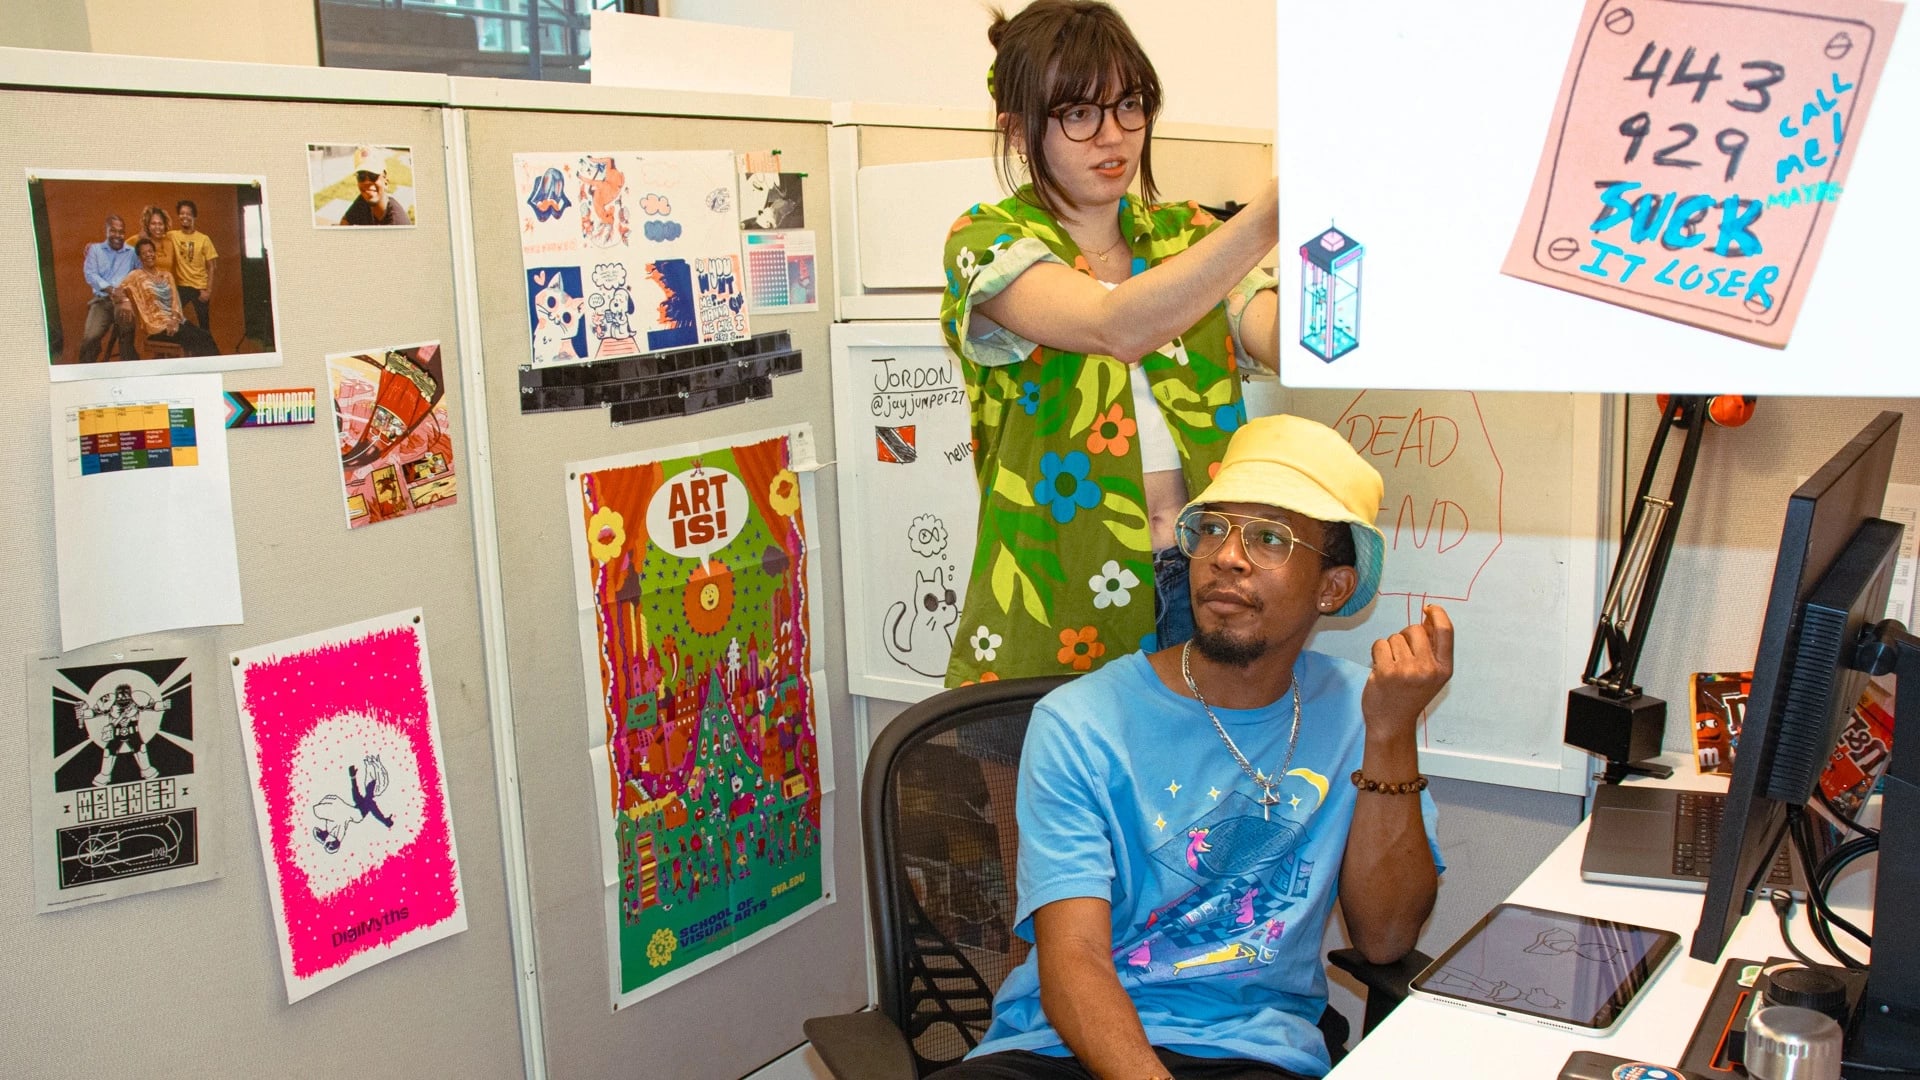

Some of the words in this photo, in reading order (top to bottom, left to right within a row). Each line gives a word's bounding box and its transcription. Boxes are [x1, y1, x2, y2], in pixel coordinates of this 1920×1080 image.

[1624, 41, 1785, 113] 443
[1779, 73, 1853, 138] CALL
[1619, 112, 1749, 182] 929
[1580, 239, 1647, 283] IT
[1654, 258, 1779, 310] LOSER
[872, 358, 952, 391] JORDON
[1347, 408, 1459, 468] DEAD
[668, 474, 729, 521] ART
[672, 510, 729, 550] IS!
[1379, 495, 1470, 554] ND
[771, 871, 806, 897] SVA.EDU
[332, 906, 409, 948] DigiMyths
[679, 907, 733, 939] SCHOOL
[737, 897, 754, 911] OF
[680, 920, 732, 947] VISUAL
[734, 900, 768, 923] ARTS
